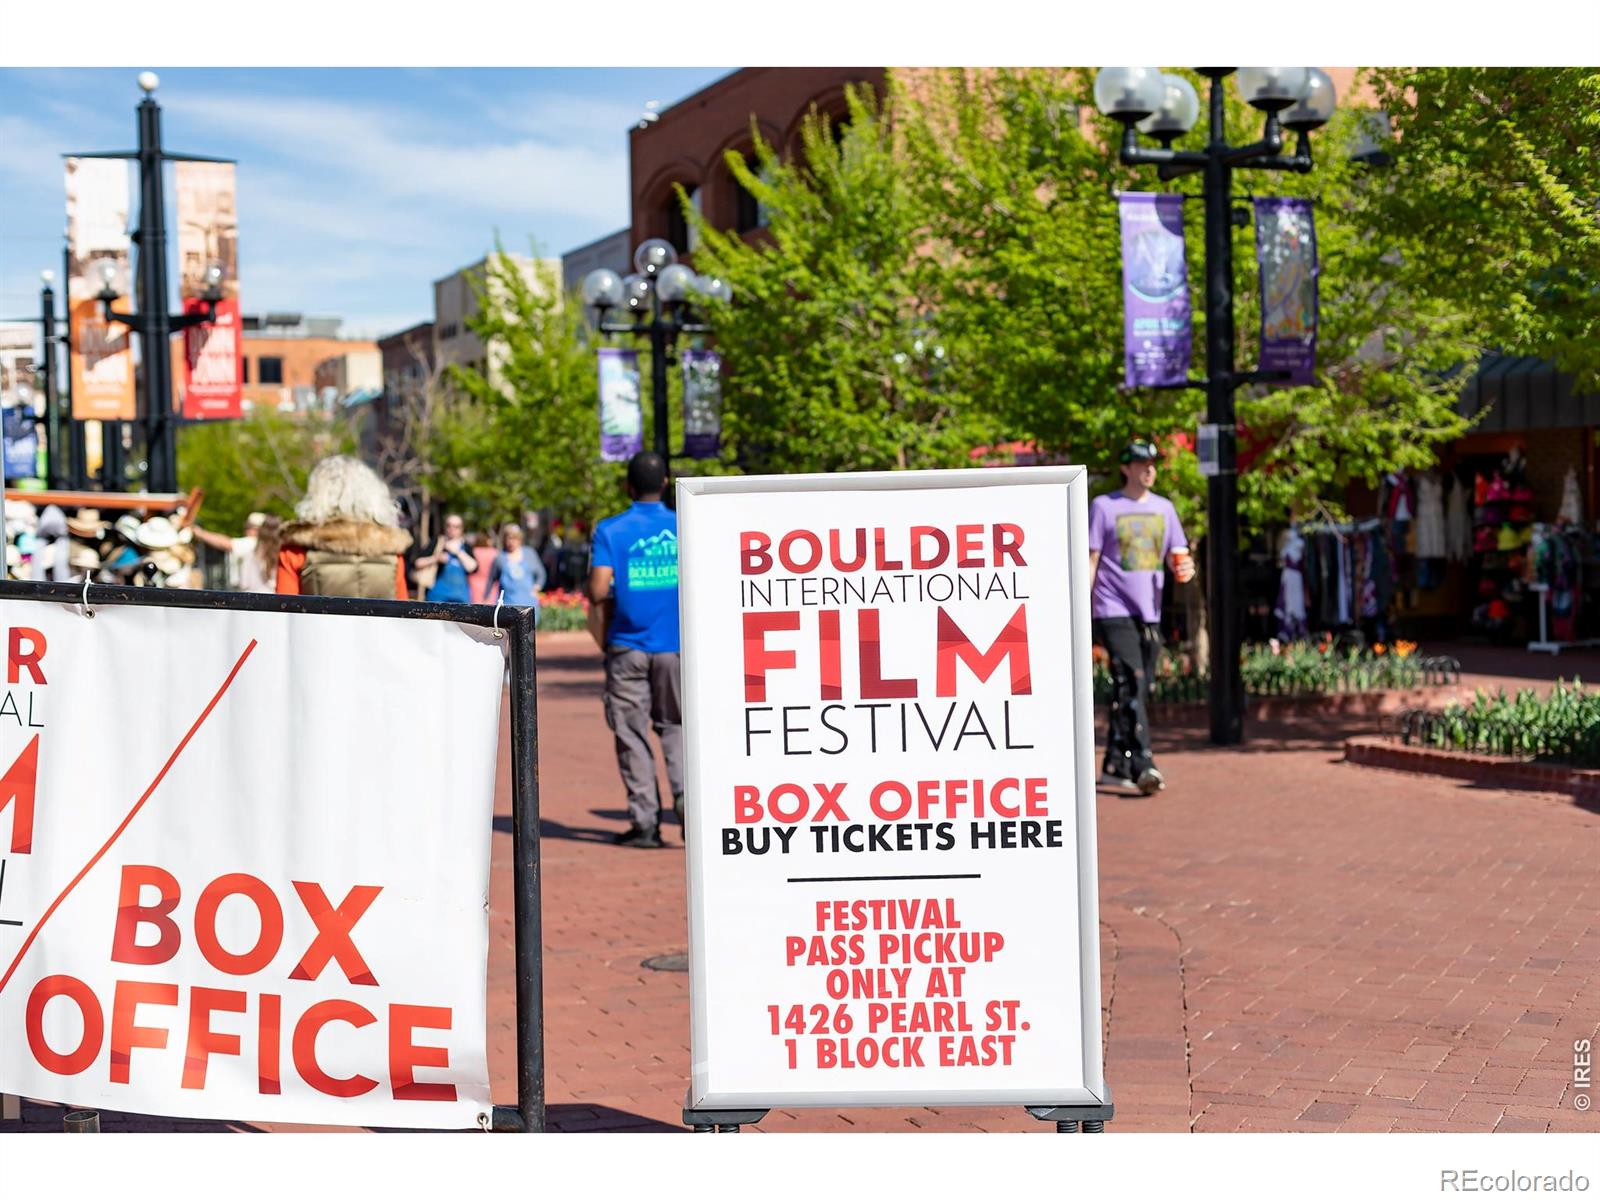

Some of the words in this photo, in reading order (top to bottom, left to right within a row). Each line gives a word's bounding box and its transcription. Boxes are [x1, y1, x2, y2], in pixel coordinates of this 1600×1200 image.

[740, 523, 1028, 575] BOULDER
[741, 572, 1029, 607] INTERNATIONAL
[743, 604, 1032, 703] FILM
[745, 701, 1034, 756] FESTIVAL
[734, 783, 850, 824] BOX
[870, 778, 1048, 821] OFFICE
[722, 826, 797, 855] BUY
[810, 822, 955, 853] TICKETS
[971, 820, 1062, 849] HERE
[111, 865, 384, 986] BOX
[816, 898, 960, 931] FESTIVAL
[786, 934, 865, 966] PASS
[879, 932, 1004, 964] PICKUP
[826, 968, 912, 1000] ONLY
[926, 967, 965, 997] AT
[768, 1004, 853, 1035] 1426
[869, 1001, 972, 1033] PEARL
[986, 1000, 1031, 1031] ST.
[26, 975, 457, 1102] OFFICE
[785, 1039, 796, 1069] 1
[817, 1037, 925, 1068] BLOCK
[939, 1035, 1015, 1066] EAST
